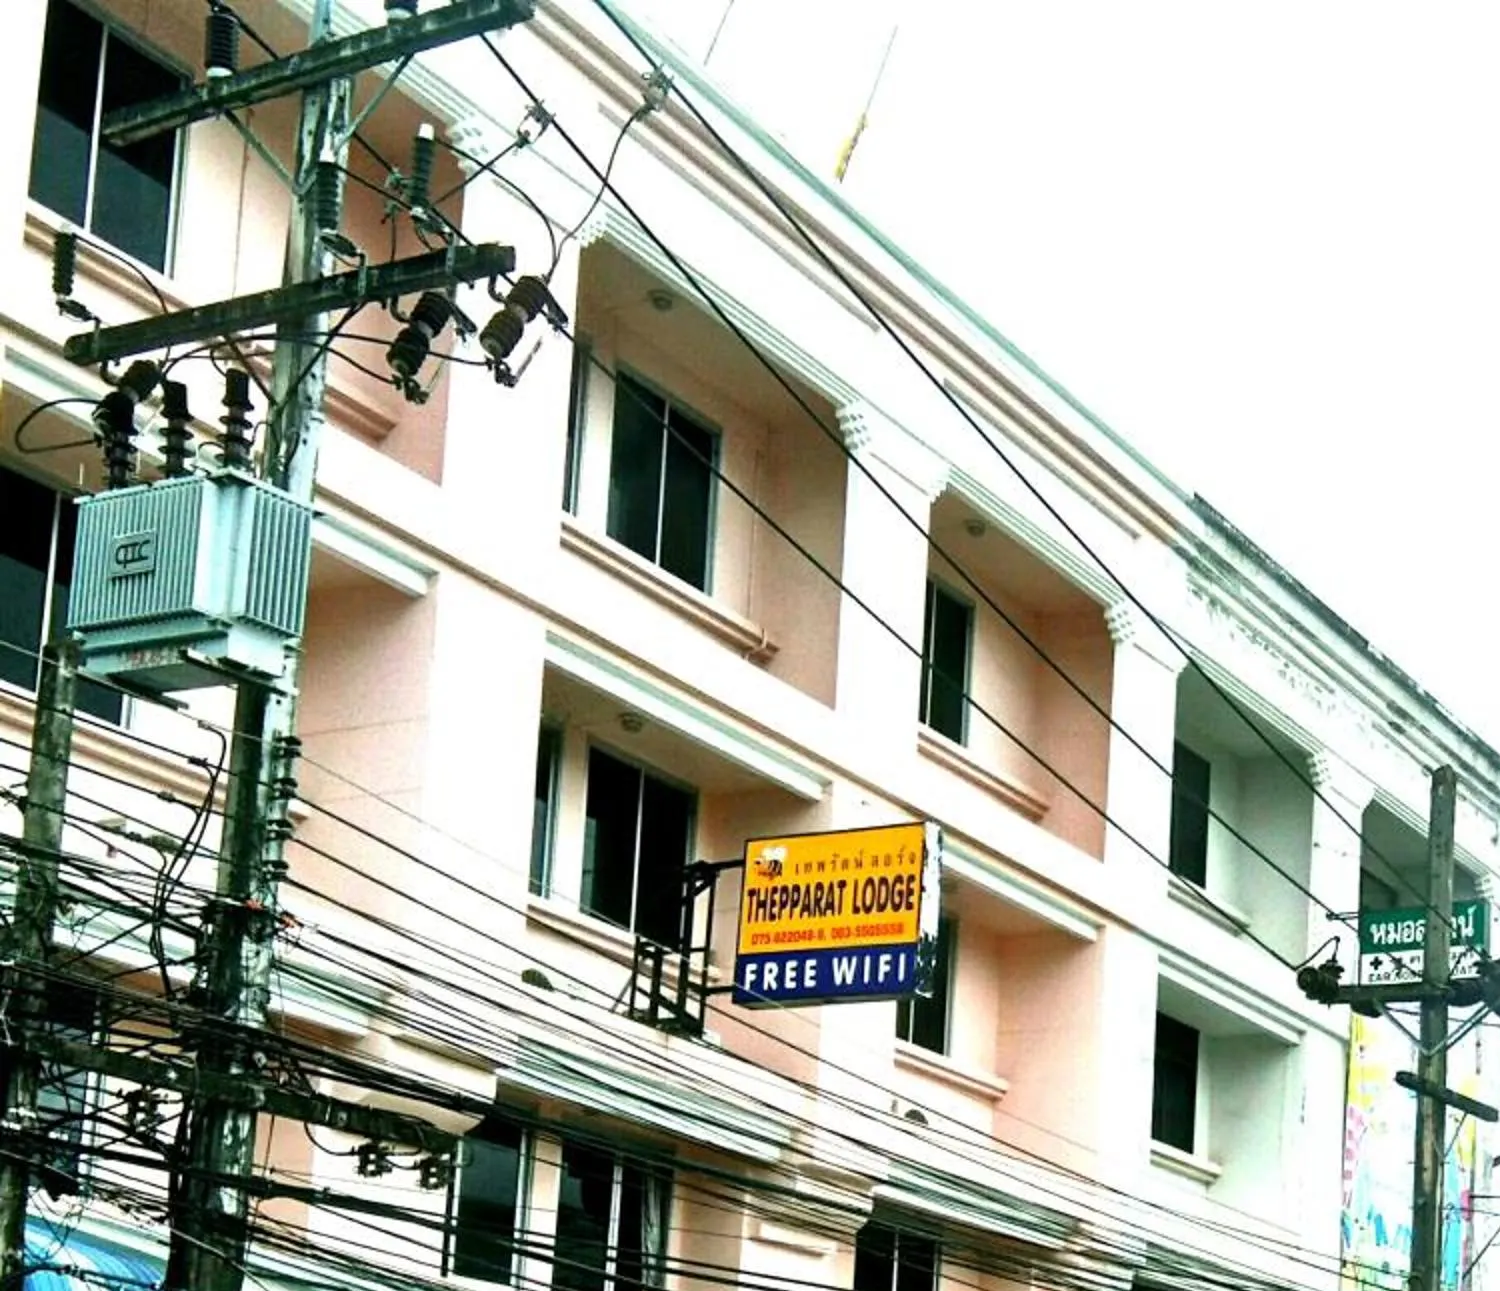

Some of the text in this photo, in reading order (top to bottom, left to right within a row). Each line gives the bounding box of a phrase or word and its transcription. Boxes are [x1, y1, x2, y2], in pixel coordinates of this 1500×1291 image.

[747, 874, 916, 923] THEPPARAT LODGE
[745, 953, 906, 991] FREE WIFI
